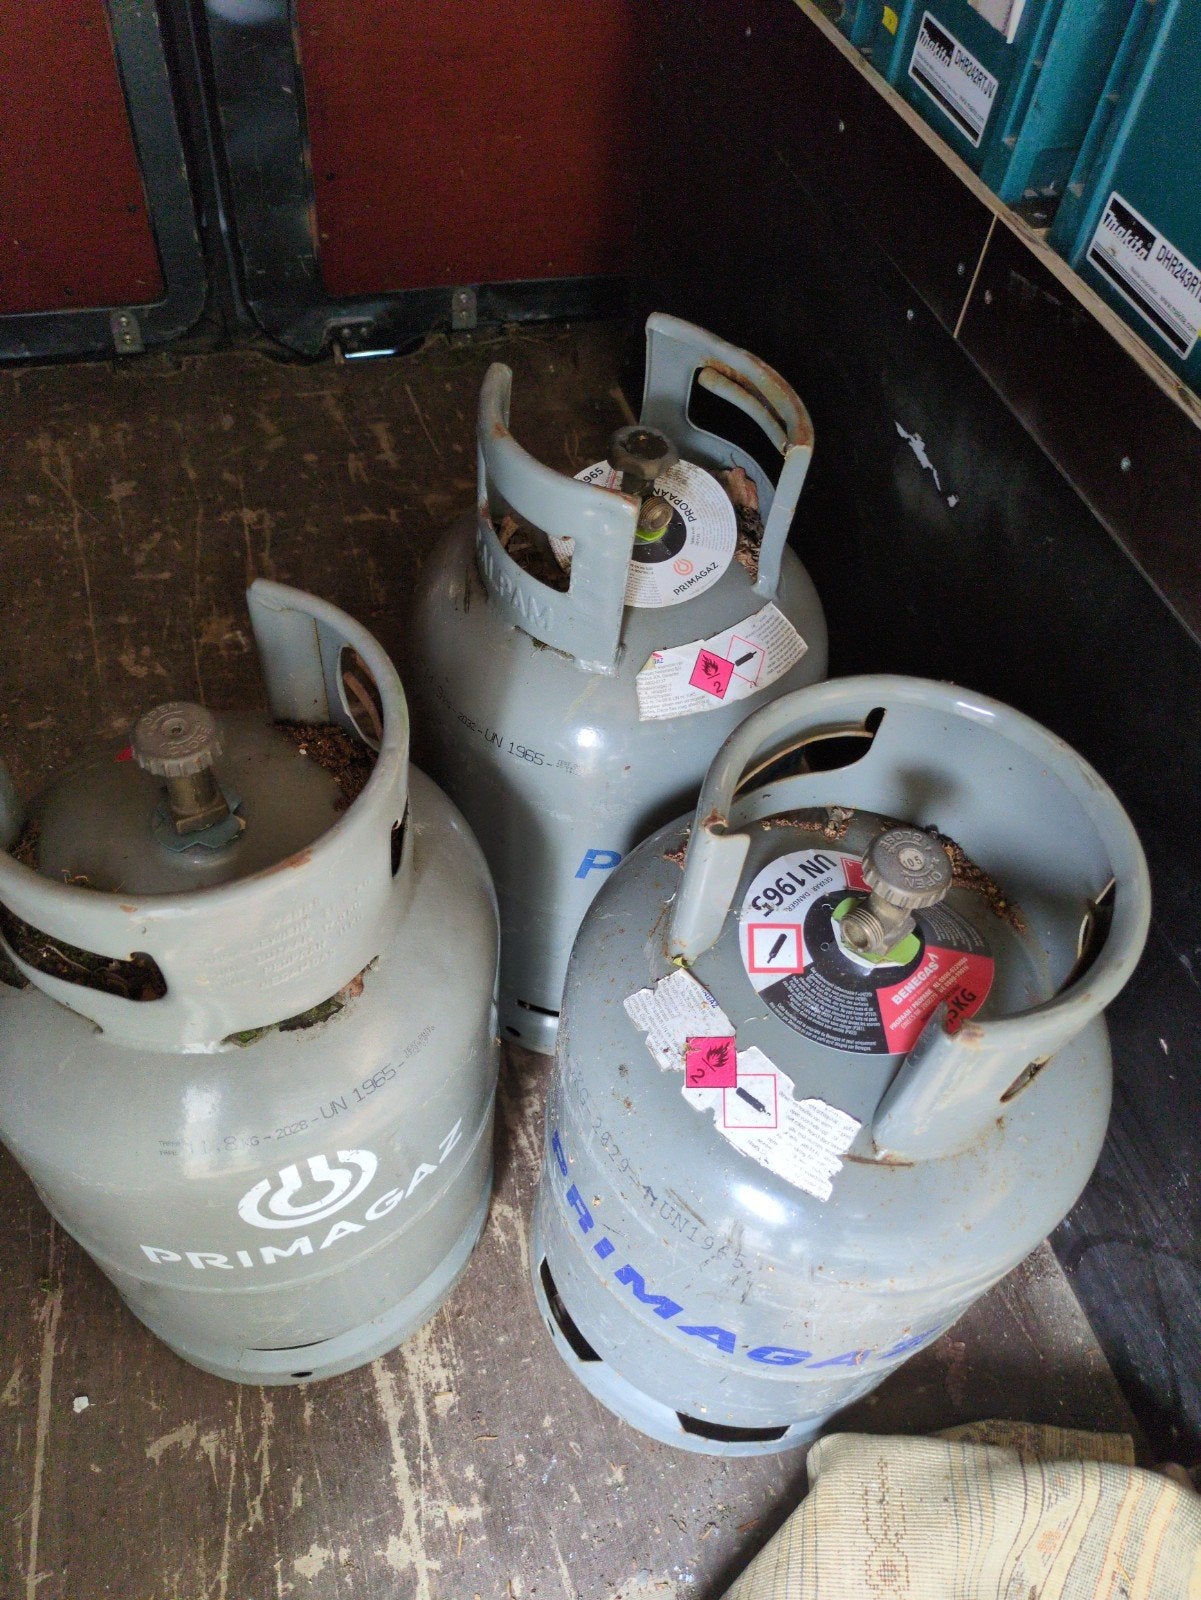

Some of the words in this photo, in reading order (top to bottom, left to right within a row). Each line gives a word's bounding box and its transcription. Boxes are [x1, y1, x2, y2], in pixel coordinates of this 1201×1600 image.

[673, 561, 720, 596] PRIMAGAZ
[713, 681, 724, 694] 2
[798, 854, 838, 879] UN
[751, 872, 806, 918] 1965
[891, 961, 939, 1005] BENEGAS
[690, 1068, 706, 1084] 2
[139, 1117, 463, 1270] PRIMAGAZ
